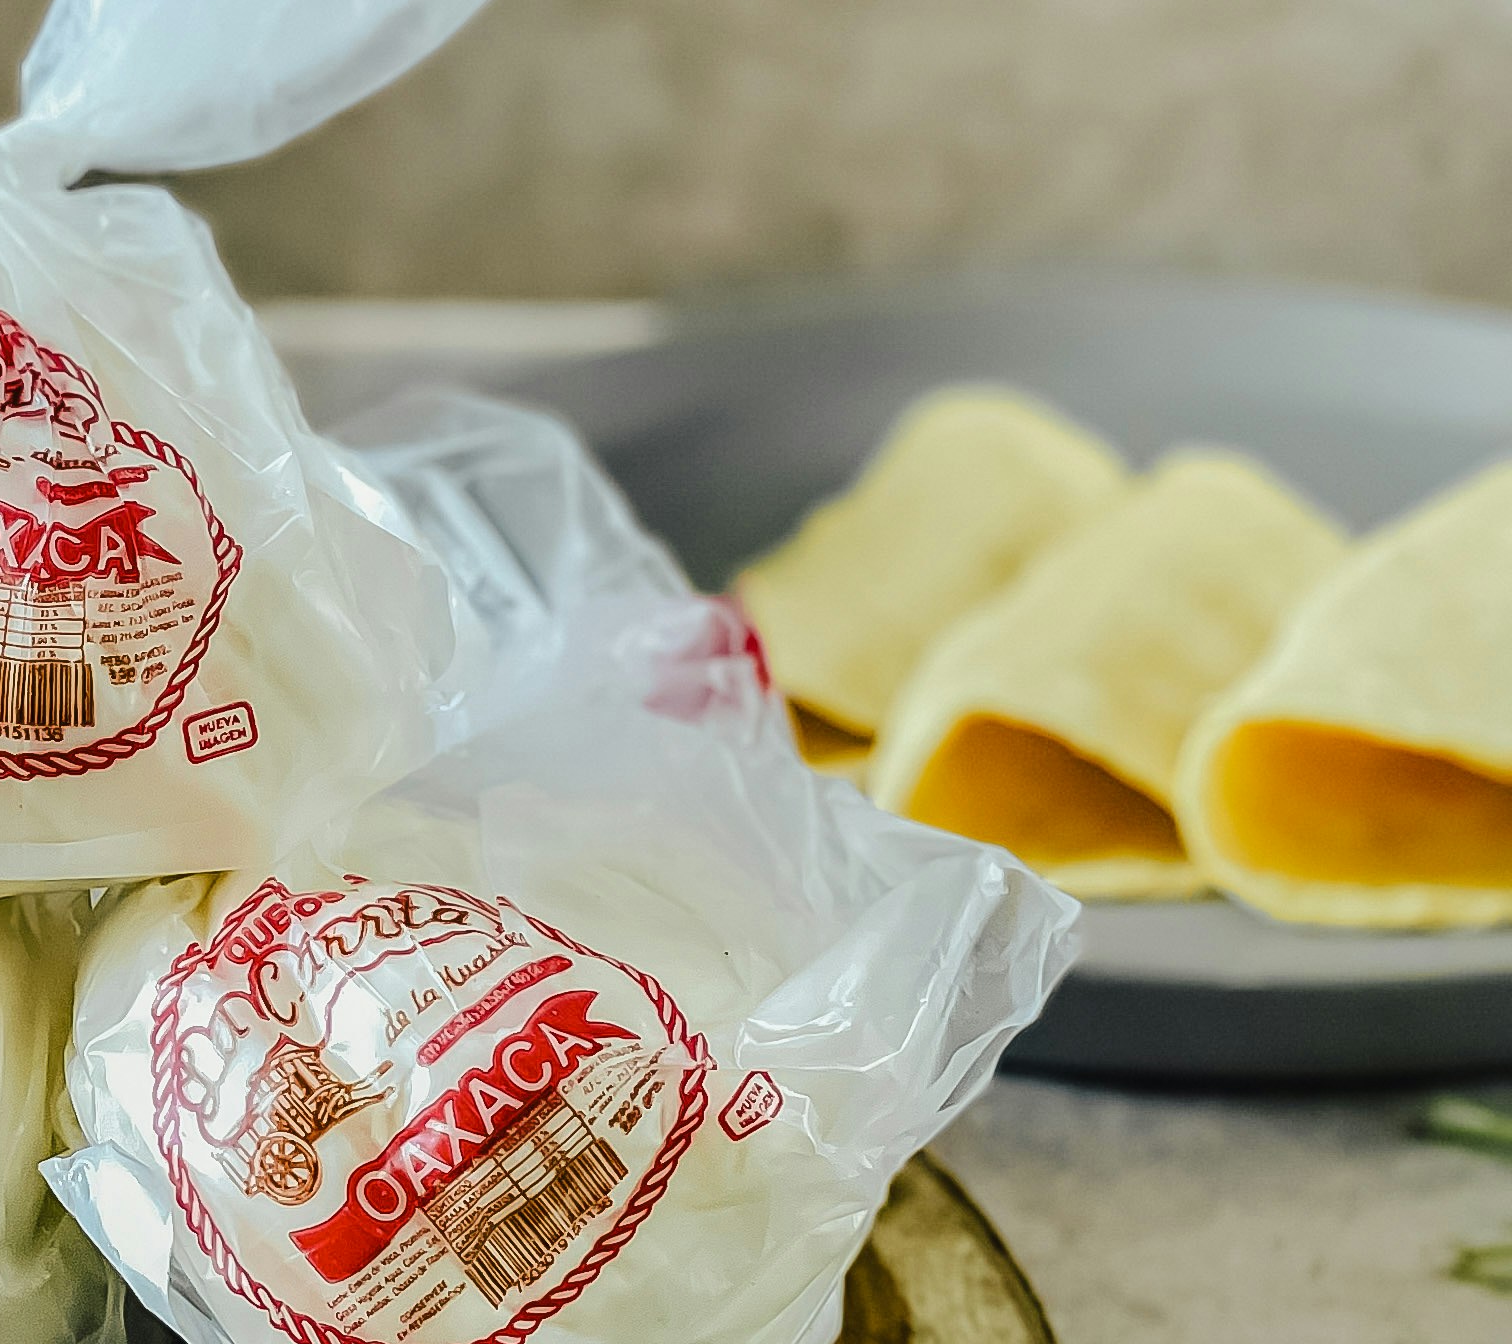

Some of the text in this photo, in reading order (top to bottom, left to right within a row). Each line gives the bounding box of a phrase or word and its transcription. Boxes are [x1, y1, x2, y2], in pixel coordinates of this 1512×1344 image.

[198, 714, 241, 736] NUEVA
[198, 728, 247, 751] IMAGEN
[224, 897, 323, 964] QUEO
[256, 894, 471, 1028] Carrta
[355, 1021, 594, 1222] OAXACA
